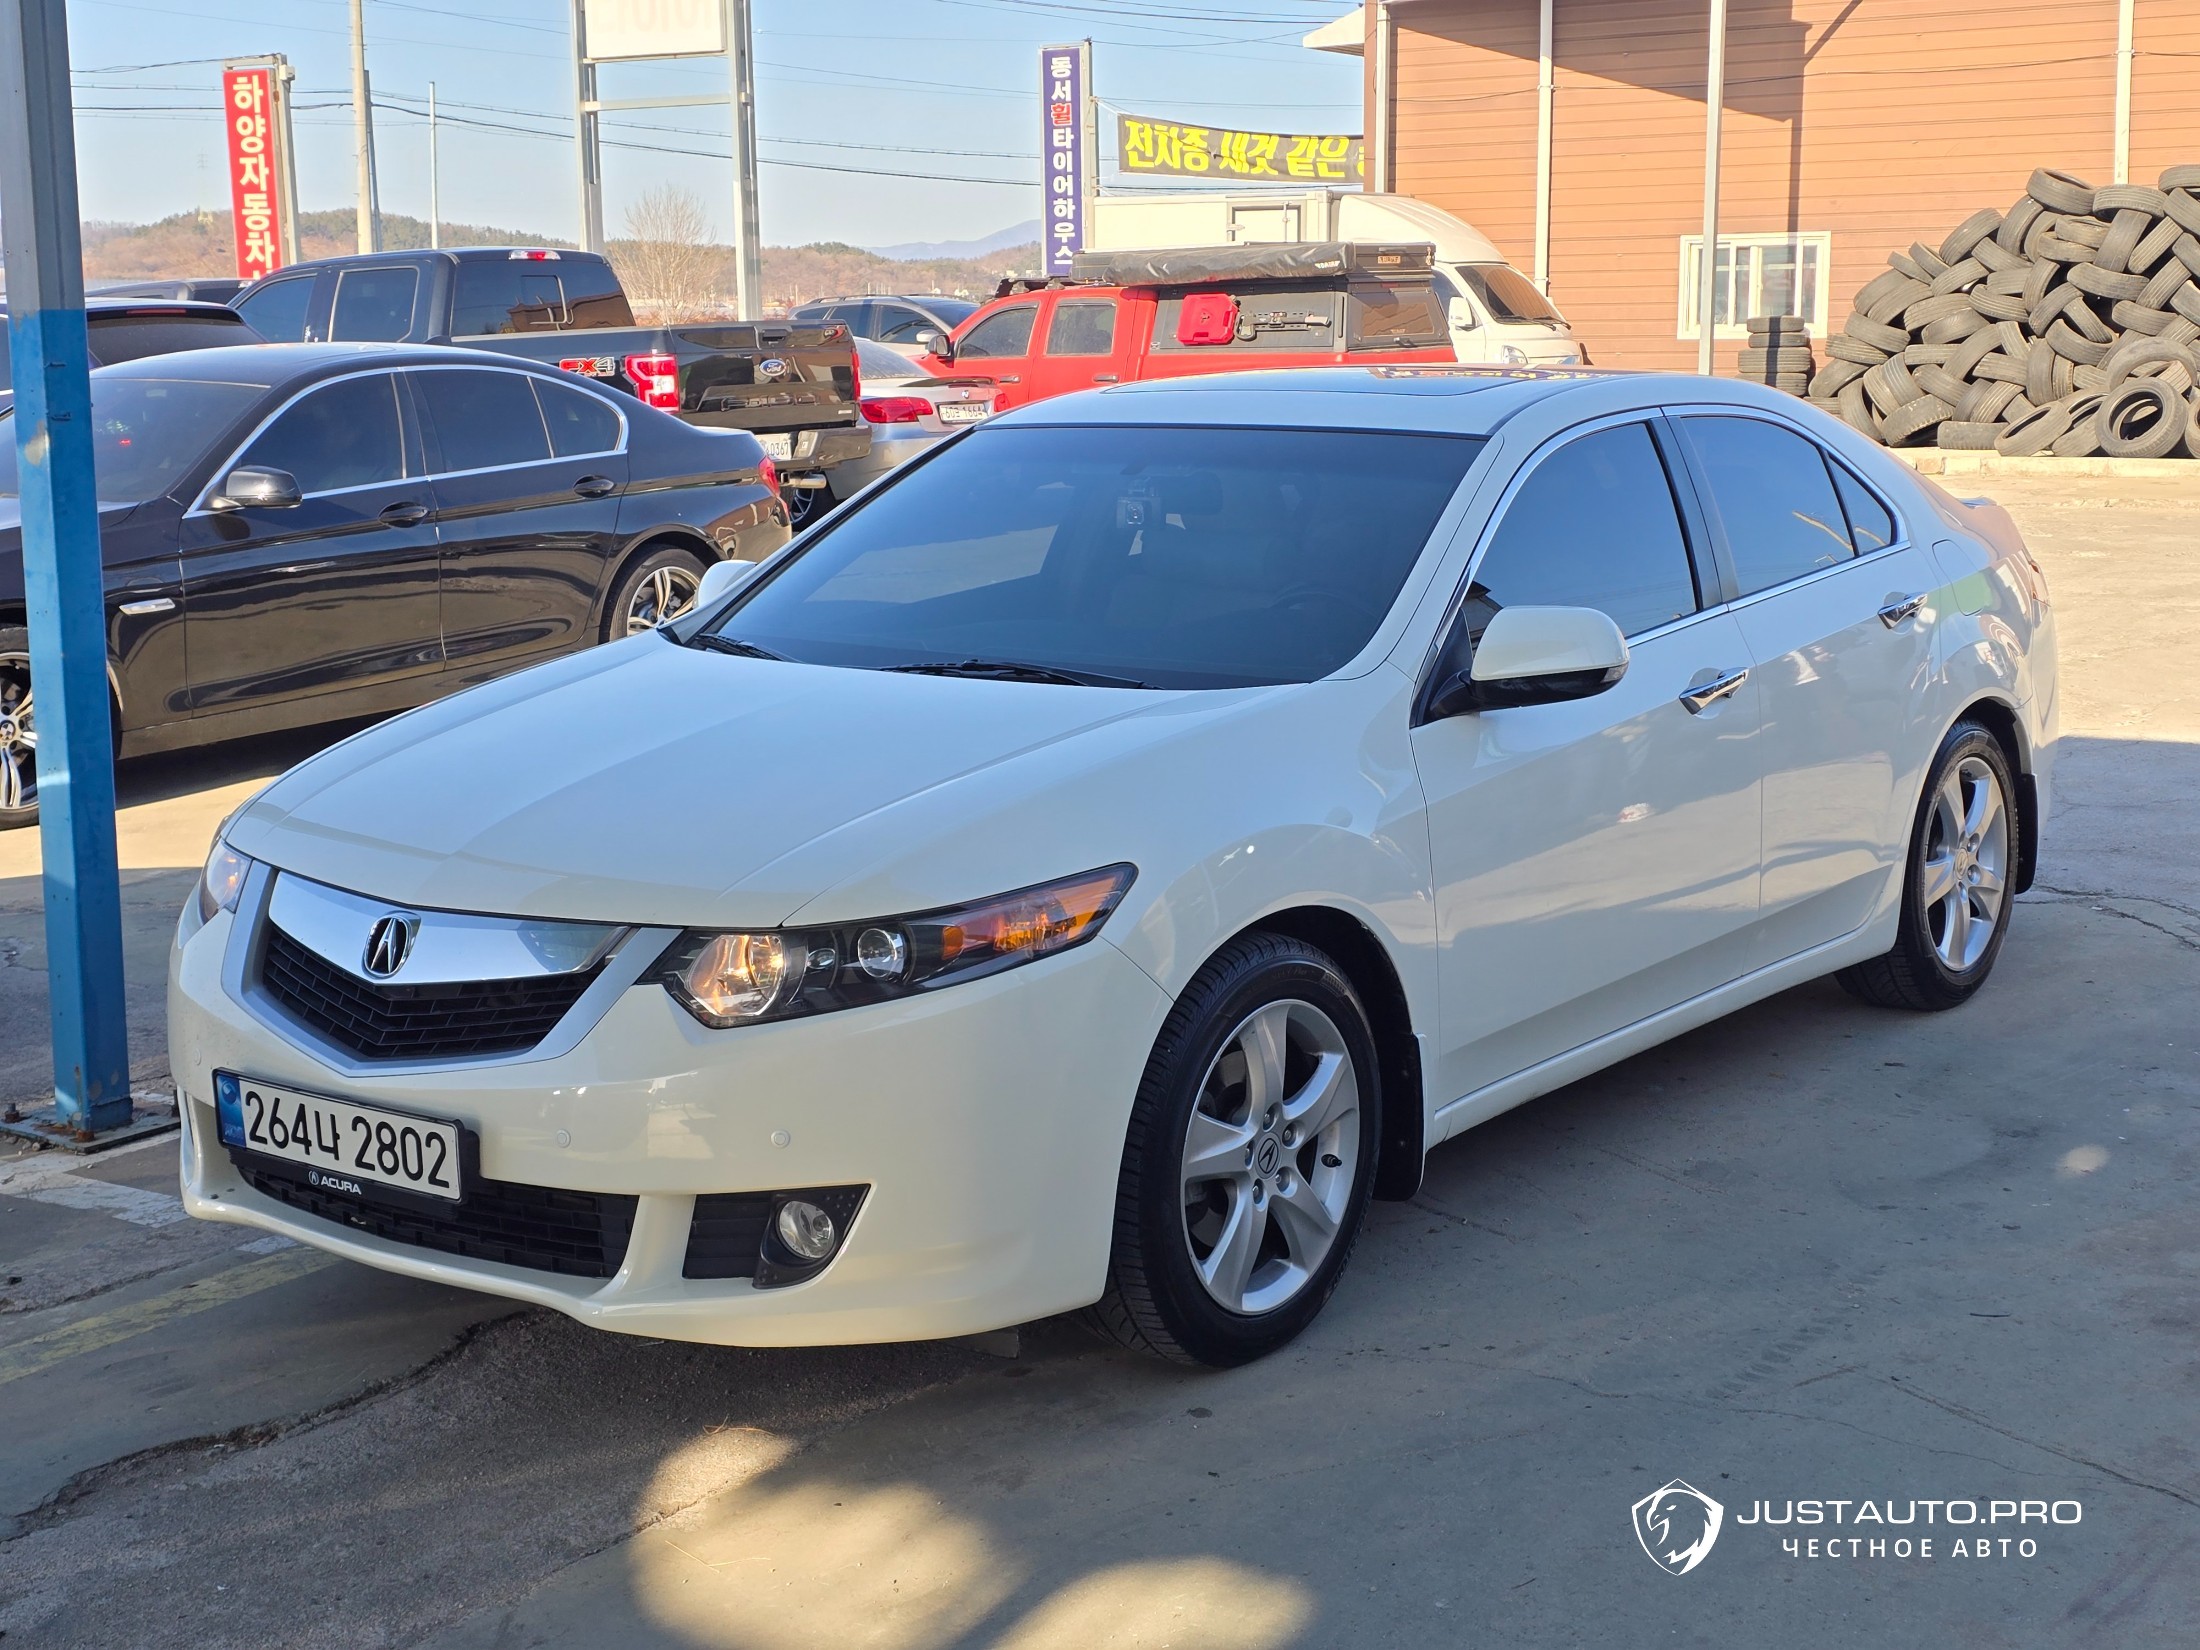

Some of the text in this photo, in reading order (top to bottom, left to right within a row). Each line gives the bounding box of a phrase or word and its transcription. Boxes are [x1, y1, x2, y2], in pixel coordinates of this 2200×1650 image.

[232, 74, 276, 279] 하양자동차
[1050, 56, 1076, 265] 동서휠타이어하우스
[1125, 120, 1210, 172] 전차종
[1219, 131, 1279, 176] 새것
[1286, 136, 1350, 178] 같은
[245, 1090, 450, 1189] 264나 2802
[321, 1175, 362, 1195] ACURA
